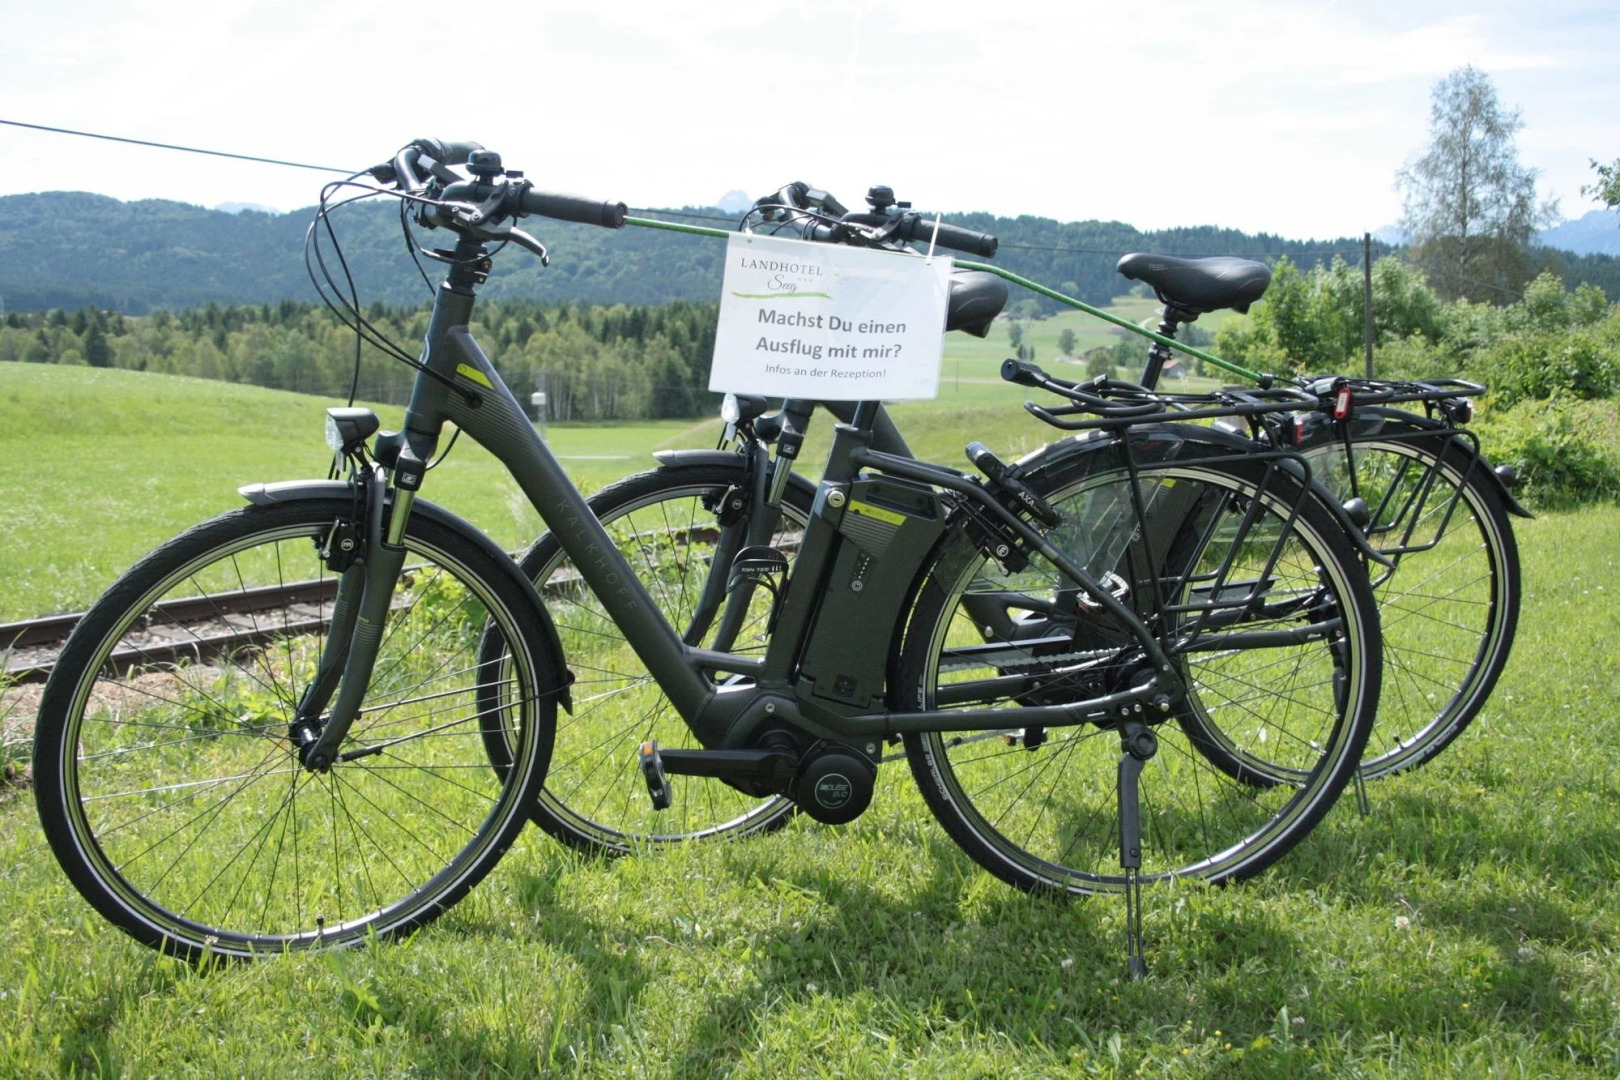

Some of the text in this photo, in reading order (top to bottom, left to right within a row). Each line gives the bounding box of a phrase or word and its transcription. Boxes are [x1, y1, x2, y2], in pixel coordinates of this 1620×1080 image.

[741, 258, 823, 276] LANDHOTEL
[767, 274, 797, 295] Seeg
[758, 308, 907, 334] Machst Du einen
[755, 336, 903, 360] Ausflug mit mir?
[765, 363, 887, 380] Infos an der Rezeption!
[1017, 491, 1035, 507] AXA
[557, 500, 638, 609] KALKHOFF
